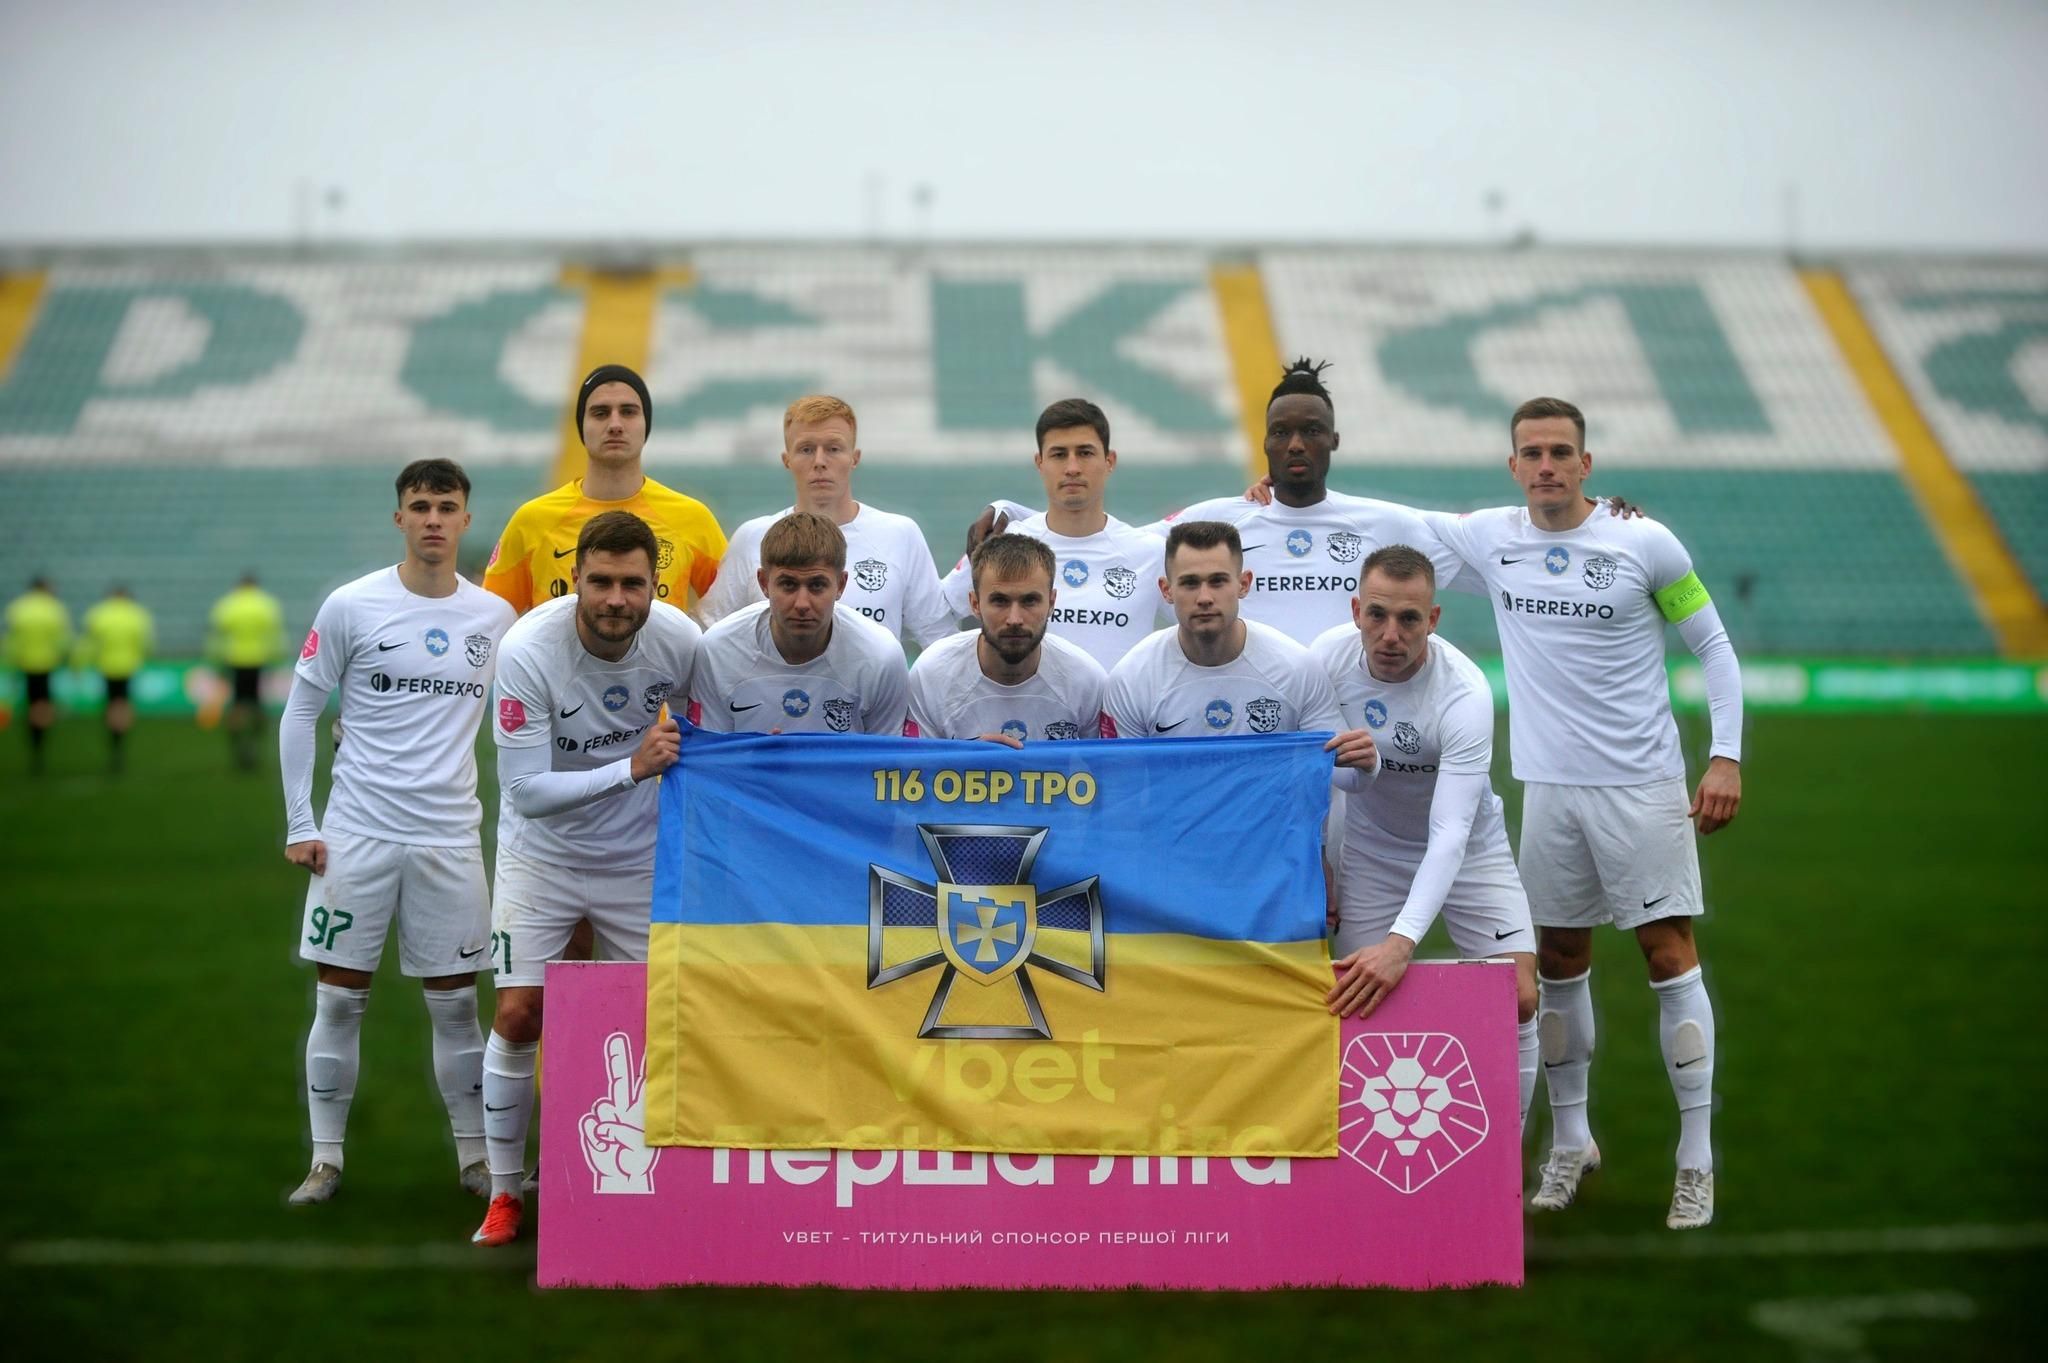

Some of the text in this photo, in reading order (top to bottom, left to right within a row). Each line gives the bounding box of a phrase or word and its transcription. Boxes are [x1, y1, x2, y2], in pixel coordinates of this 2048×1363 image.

[1255, 576, 1358, 592] FERREXPO
[1515, 597, 1614, 620] FERREXPO
[396, 678, 485, 699] FERREXPO
[873, 769, 1098, 806] 116 ОБР ТРО
[308, 905, 354, 951] 97
[782, 1231, 833, 1244] VBET
[859, 1230, 983, 1244] ТИТУЛЬНИЙ
[991, 1231, 1091, 1245] СПОНСОР
[1099, 1229, 1176, 1244] ПЕРШОЇ
[1184, 1231, 1230, 1244] ЛІГИ
